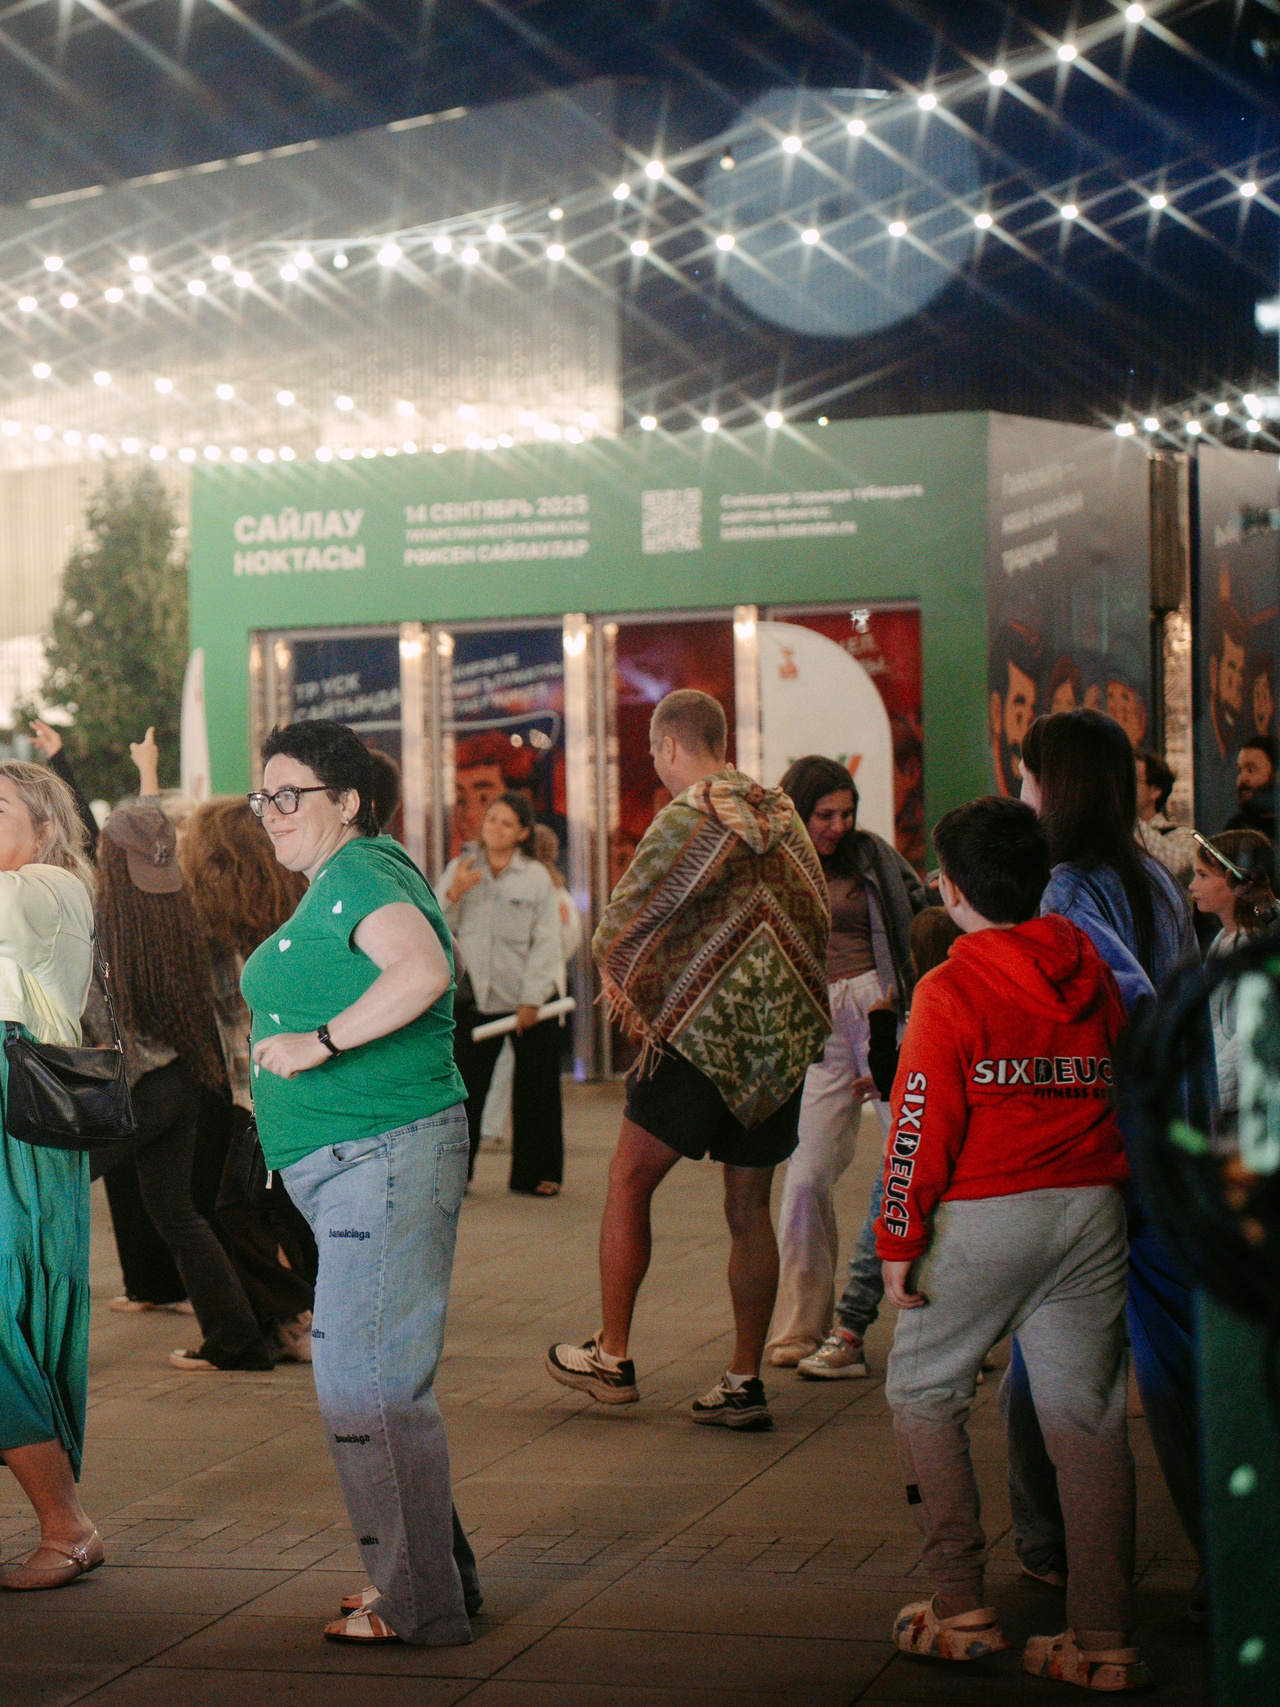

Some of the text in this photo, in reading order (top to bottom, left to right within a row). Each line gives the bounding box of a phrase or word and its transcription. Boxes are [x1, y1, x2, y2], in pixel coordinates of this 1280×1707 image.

[403, 494, 590, 524] 14 СЕНТЯБРЬ 2025
[233, 506, 365, 544] САЙЛАУ
[233, 544, 366, 576] НОКТАСЫ
[477, 538, 590, 564] САЙЛАУЛАР
[972, 1056, 1113, 1086] SIXDEUC
[1033, 1087, 1089, 1099] FITNESS
[885, 1071, 929, 1238] SIXDEUCE
